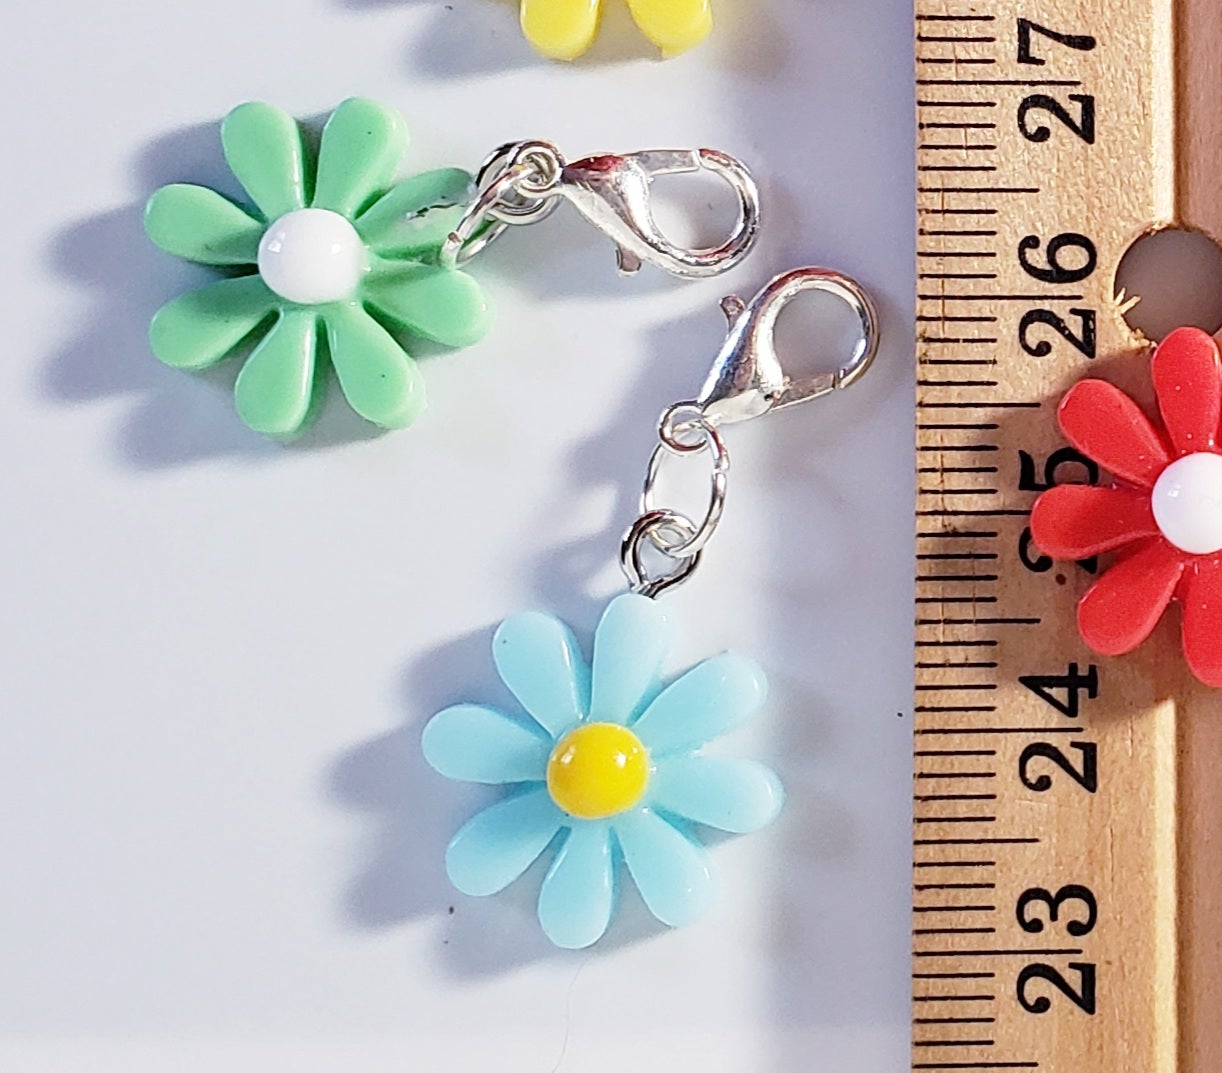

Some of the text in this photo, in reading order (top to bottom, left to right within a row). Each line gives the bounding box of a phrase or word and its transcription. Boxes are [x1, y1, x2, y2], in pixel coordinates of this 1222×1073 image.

[1016, 17, 1097, 145] 27
[1018, 232, 1098, 359] 26
[1018, 662, 1098, 793] 24
[1016, 884, 1098, 1015] 23
